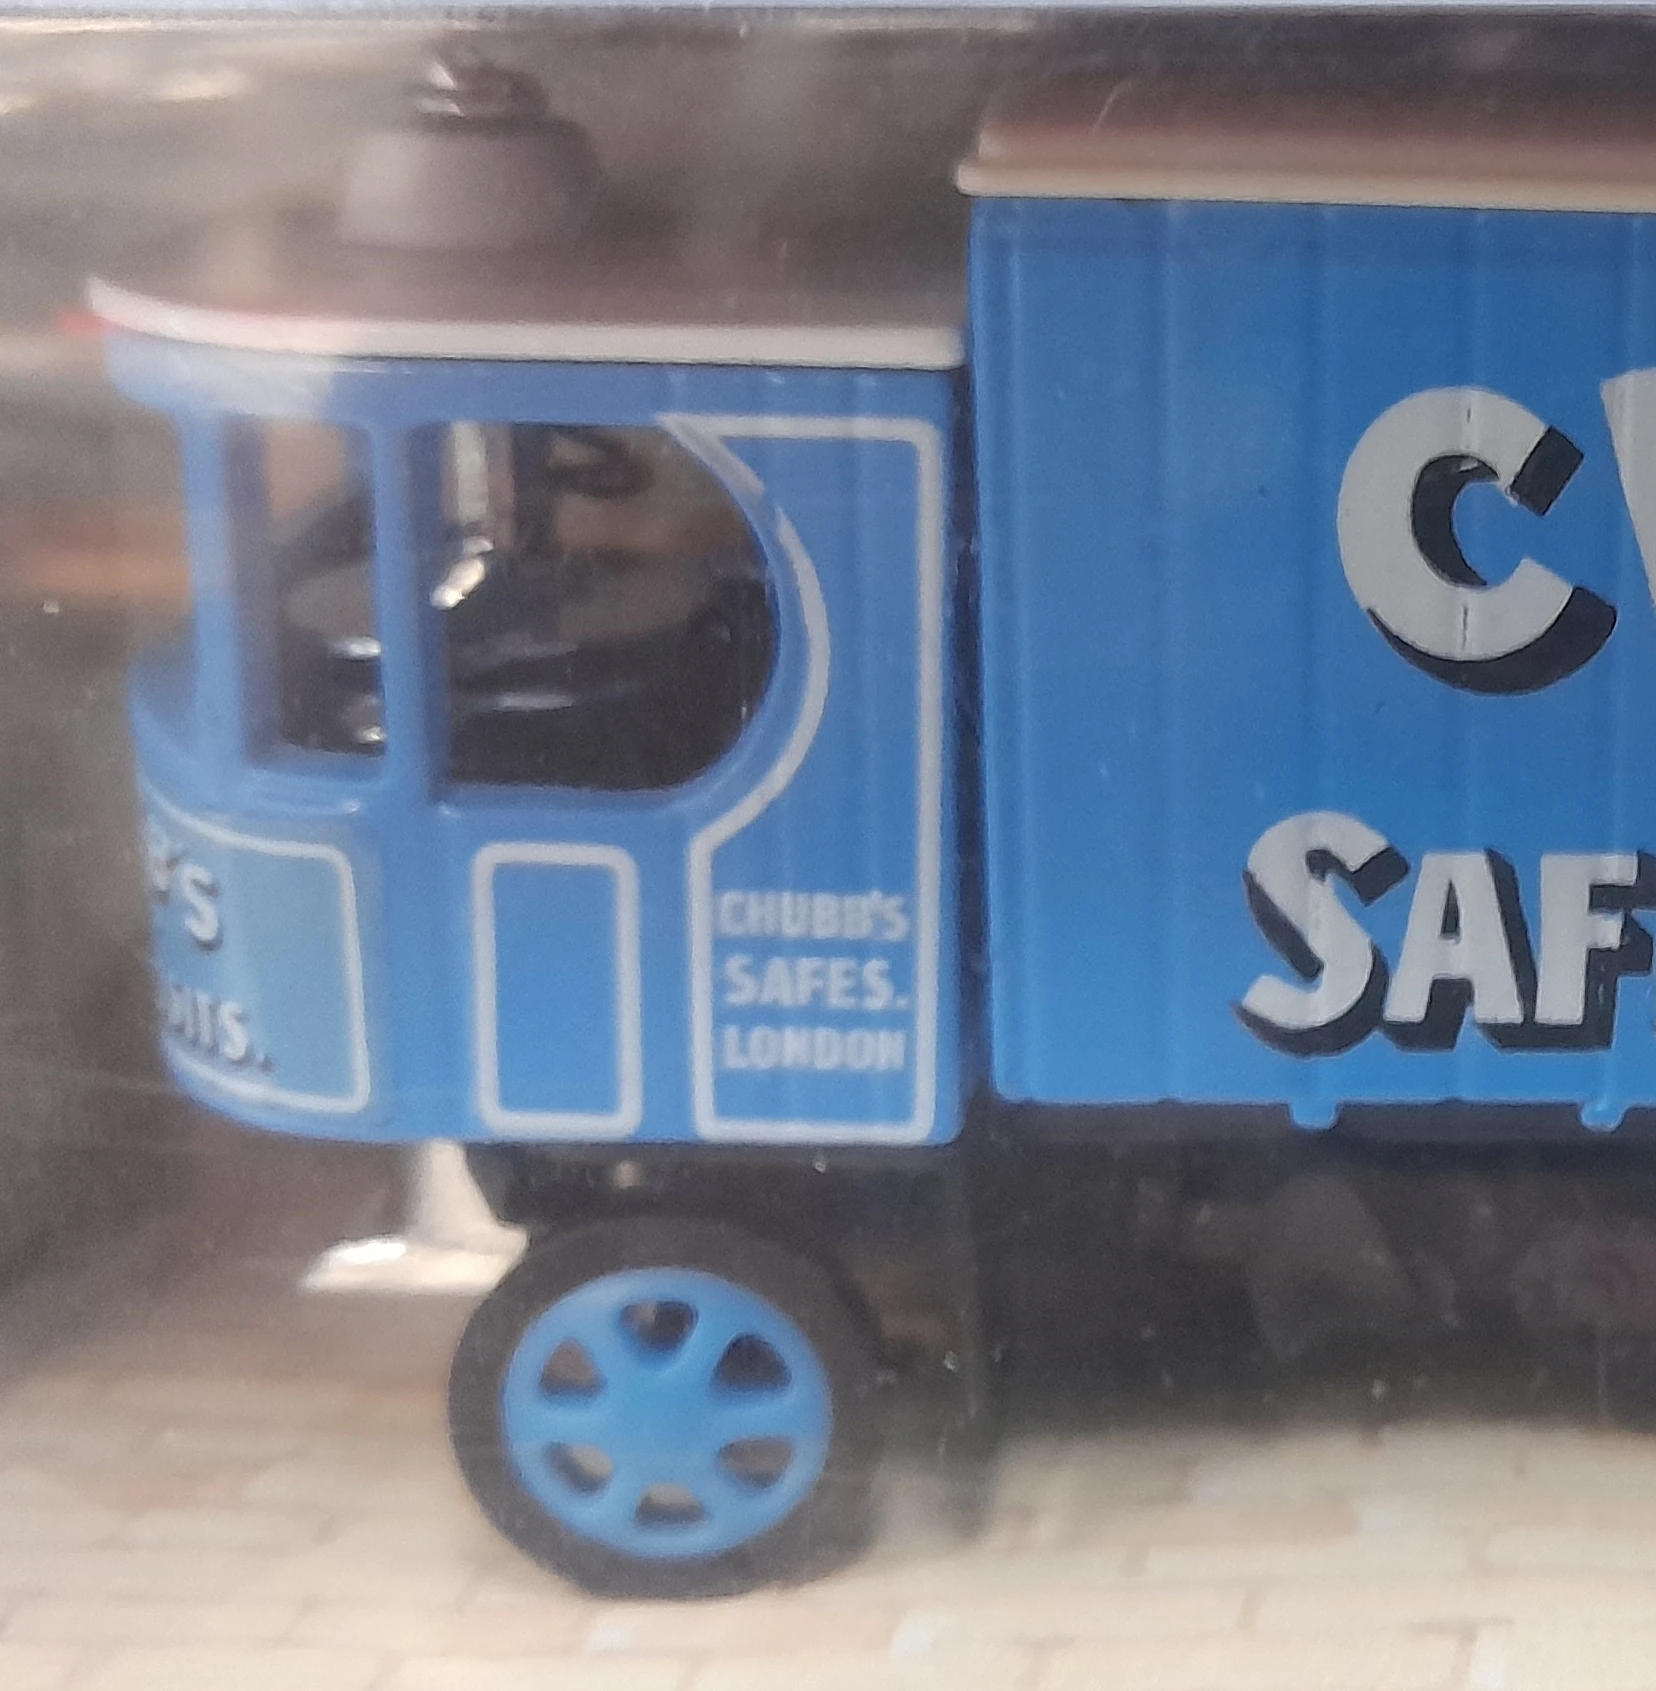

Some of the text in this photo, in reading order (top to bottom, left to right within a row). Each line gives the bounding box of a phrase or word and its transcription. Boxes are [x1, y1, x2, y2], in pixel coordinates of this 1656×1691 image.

[719, 889, 910, 941] CHUBB'S
[724, 955, 909, 1010] SAFES.
[722, 1025, 906, 1070] LONDON
